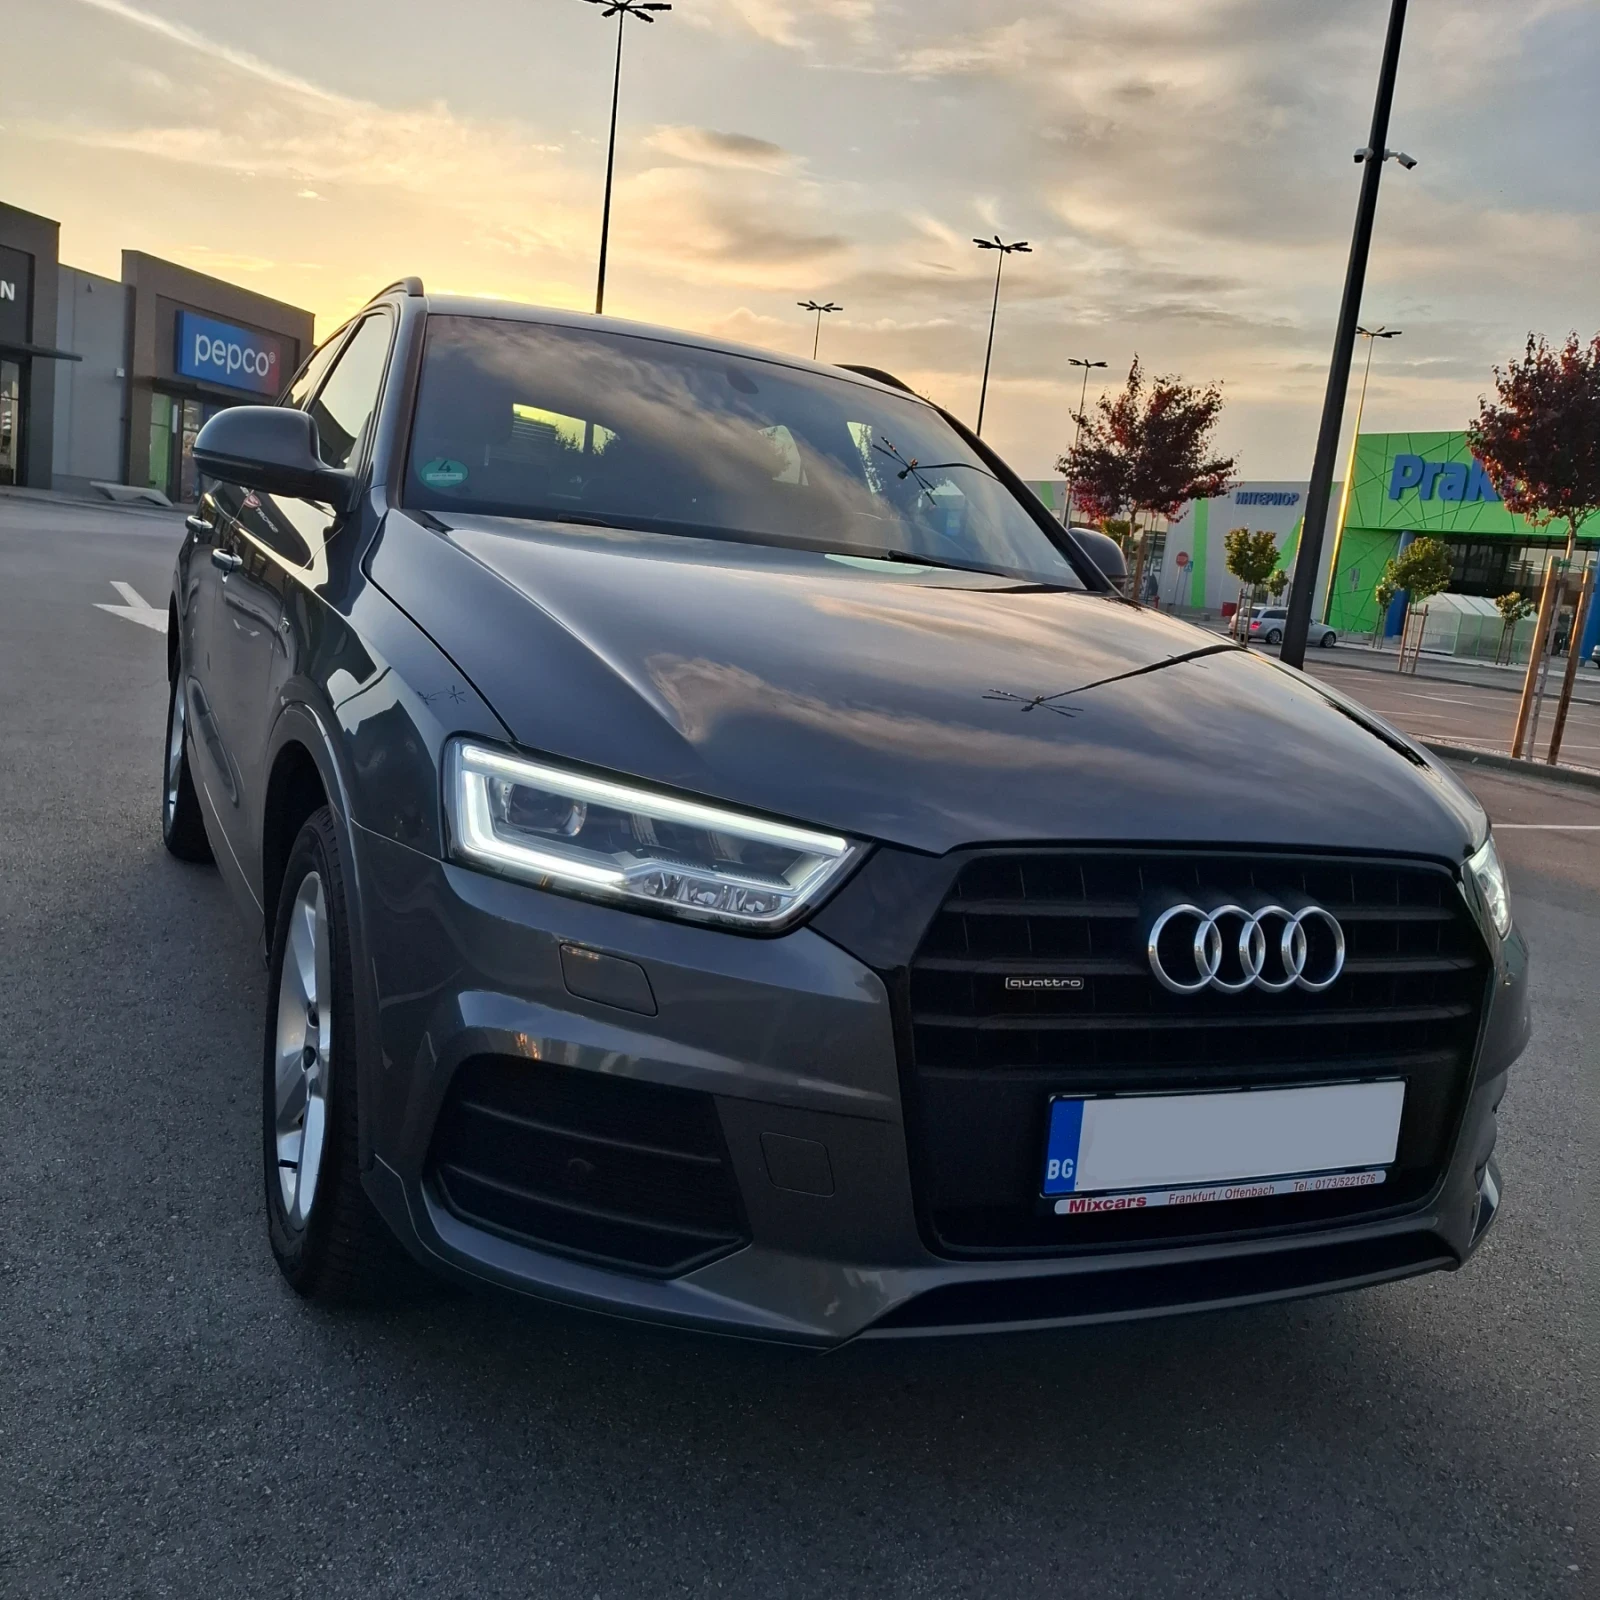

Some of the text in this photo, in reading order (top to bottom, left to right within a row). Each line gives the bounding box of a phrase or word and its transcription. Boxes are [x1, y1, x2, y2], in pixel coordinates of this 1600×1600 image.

[437, 460, 452, 473] 4
[1389, 453, 1508, 502] Prak
[1010, 978, 1081, 988] quattro
[1047, 1158, 1074, 1180] BG
[1069, 1196, 1147, 1213] Mixcars
[1168, 1190, 1216, 1204] Frankfurt
[1224, 1184, 1275, 1199] Offenbach
[1294, 1180, 1313, 1192] Tel.:
[1315, 1173, 1376, 1190] 0173/5221676
